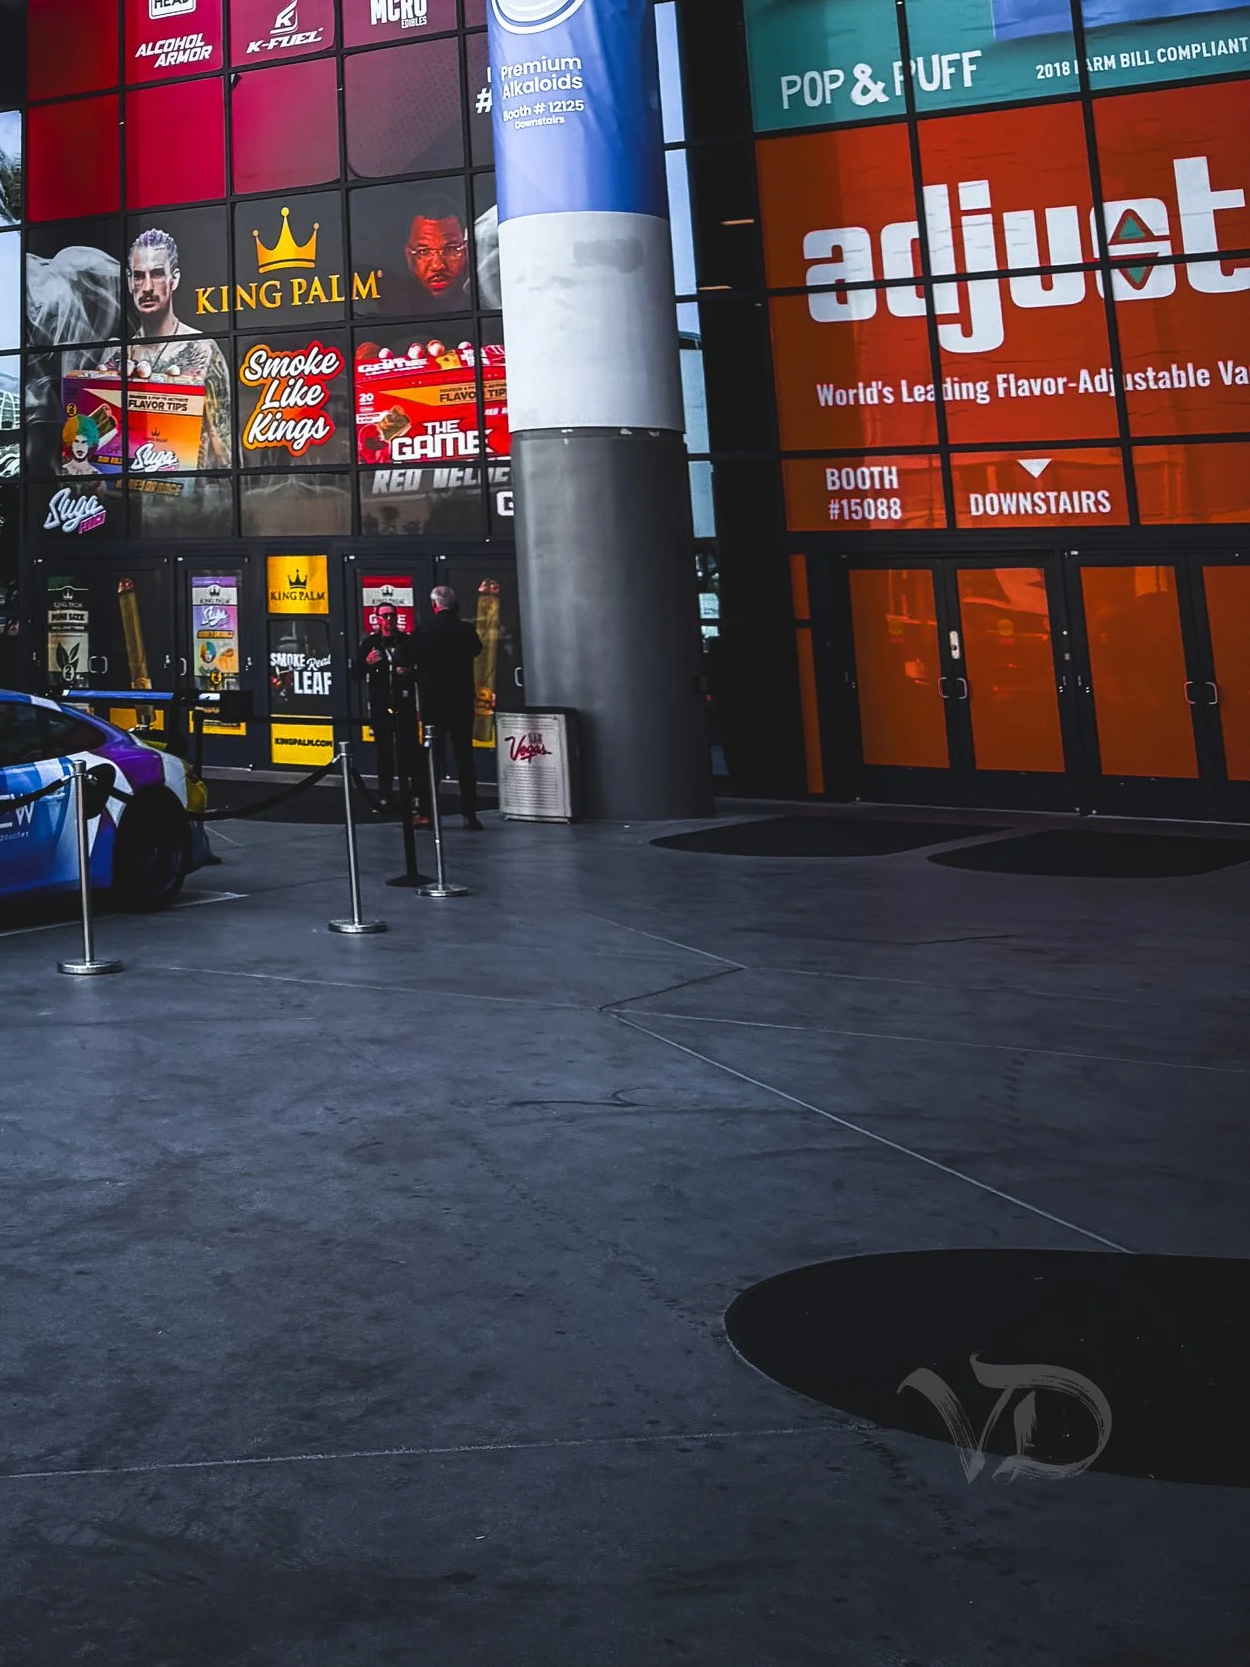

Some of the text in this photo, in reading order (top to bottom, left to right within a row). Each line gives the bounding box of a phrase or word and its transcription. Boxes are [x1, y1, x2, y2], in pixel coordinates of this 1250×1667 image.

[135, 33, 205, 58] ALCOHOL
[246, 30, 323, 54] K-FUEL
[154, 45, 213, 69] ARMOR
[501, 55, 582, 82] Premium
[1035, 61, 1071, 81] 2018
[1120, 49, 1154, 70] BILL
[1156, 36, 1249, 65] COMPLIANT
[502, 73, 583, 101] Alkaloids
[781, 49, 983, 110] POP & PUFF
[503, 100, 585, 122] Booth # 12125
[514, 115, 566, 130] Downstairs
[195, 270, 381, 316] KING PALM
[245, 346, 340, 380] Smoke
[262, 379, 324, 412] Like
[359, 392, 374, 402] 20
[816, 381, 895, 408] World's
[901, 376, 991, 405] Leading
[996, 363, 1211, 399] Flavor-Adjustable
[129, 399, 188, 412] FLAVOR TIPS
[249, 413, 330, 452] Kings
[422, 420, 461, 435] THE
[392, 429, 494, 461] GAME
[372, 469, 423, 494] RED
[826, 466, 899, 491] BOOTH
[828, 497, 902, 521] #15088
[970, 490, 1111, 517] DOWNSTAIRS
[271, 591, 326, 601] KING PALM
[270, 652, 331, 672] SMOKE Real
[293, 670, 333, 695] LEAF
